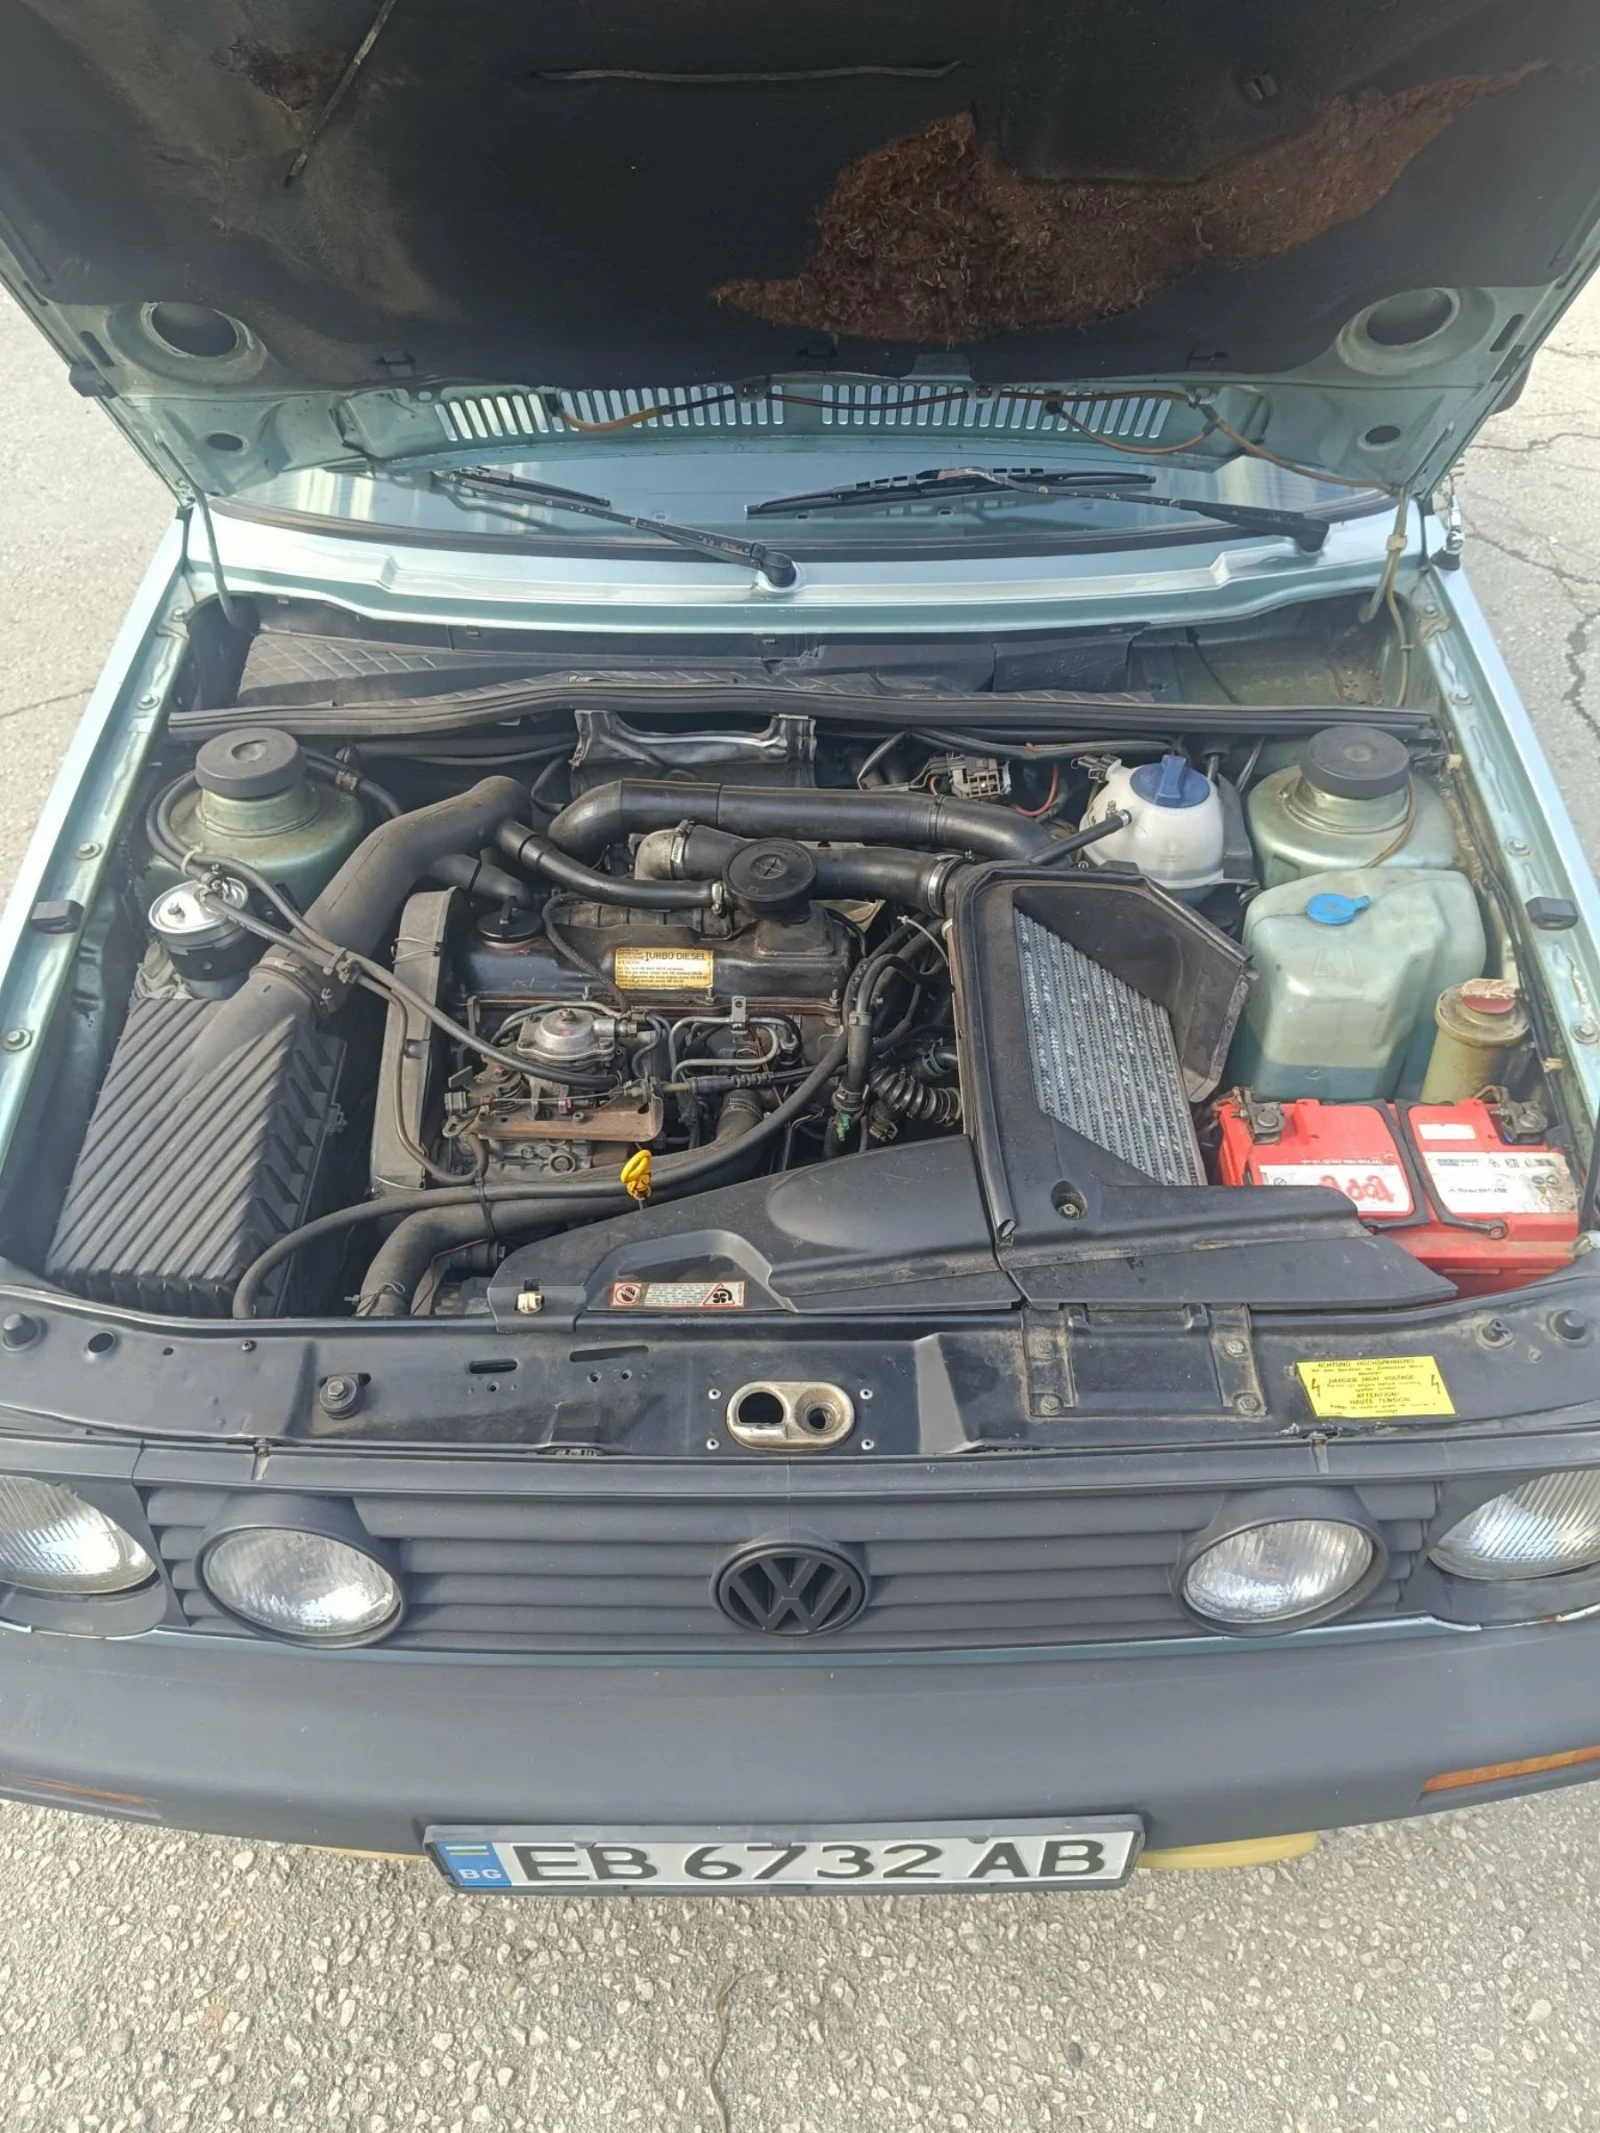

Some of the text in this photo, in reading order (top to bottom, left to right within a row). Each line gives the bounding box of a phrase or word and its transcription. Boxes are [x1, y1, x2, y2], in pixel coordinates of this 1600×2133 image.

[645, 951, 674, 962] TURBO
[676, 951, 707, 961] DIESEL
[1328, 1376, 1358, 1384] DANGER
[1361, 1375, 1380, 1383] HIGH
[1383, 1373, 1415, 1382] VOLTAGE
[1349, 1397, 1375, 1405] HAUTE
[511, 1839, 1106, 1882] EB 6732 AB
[457, 1867, 502, 1881] BG
